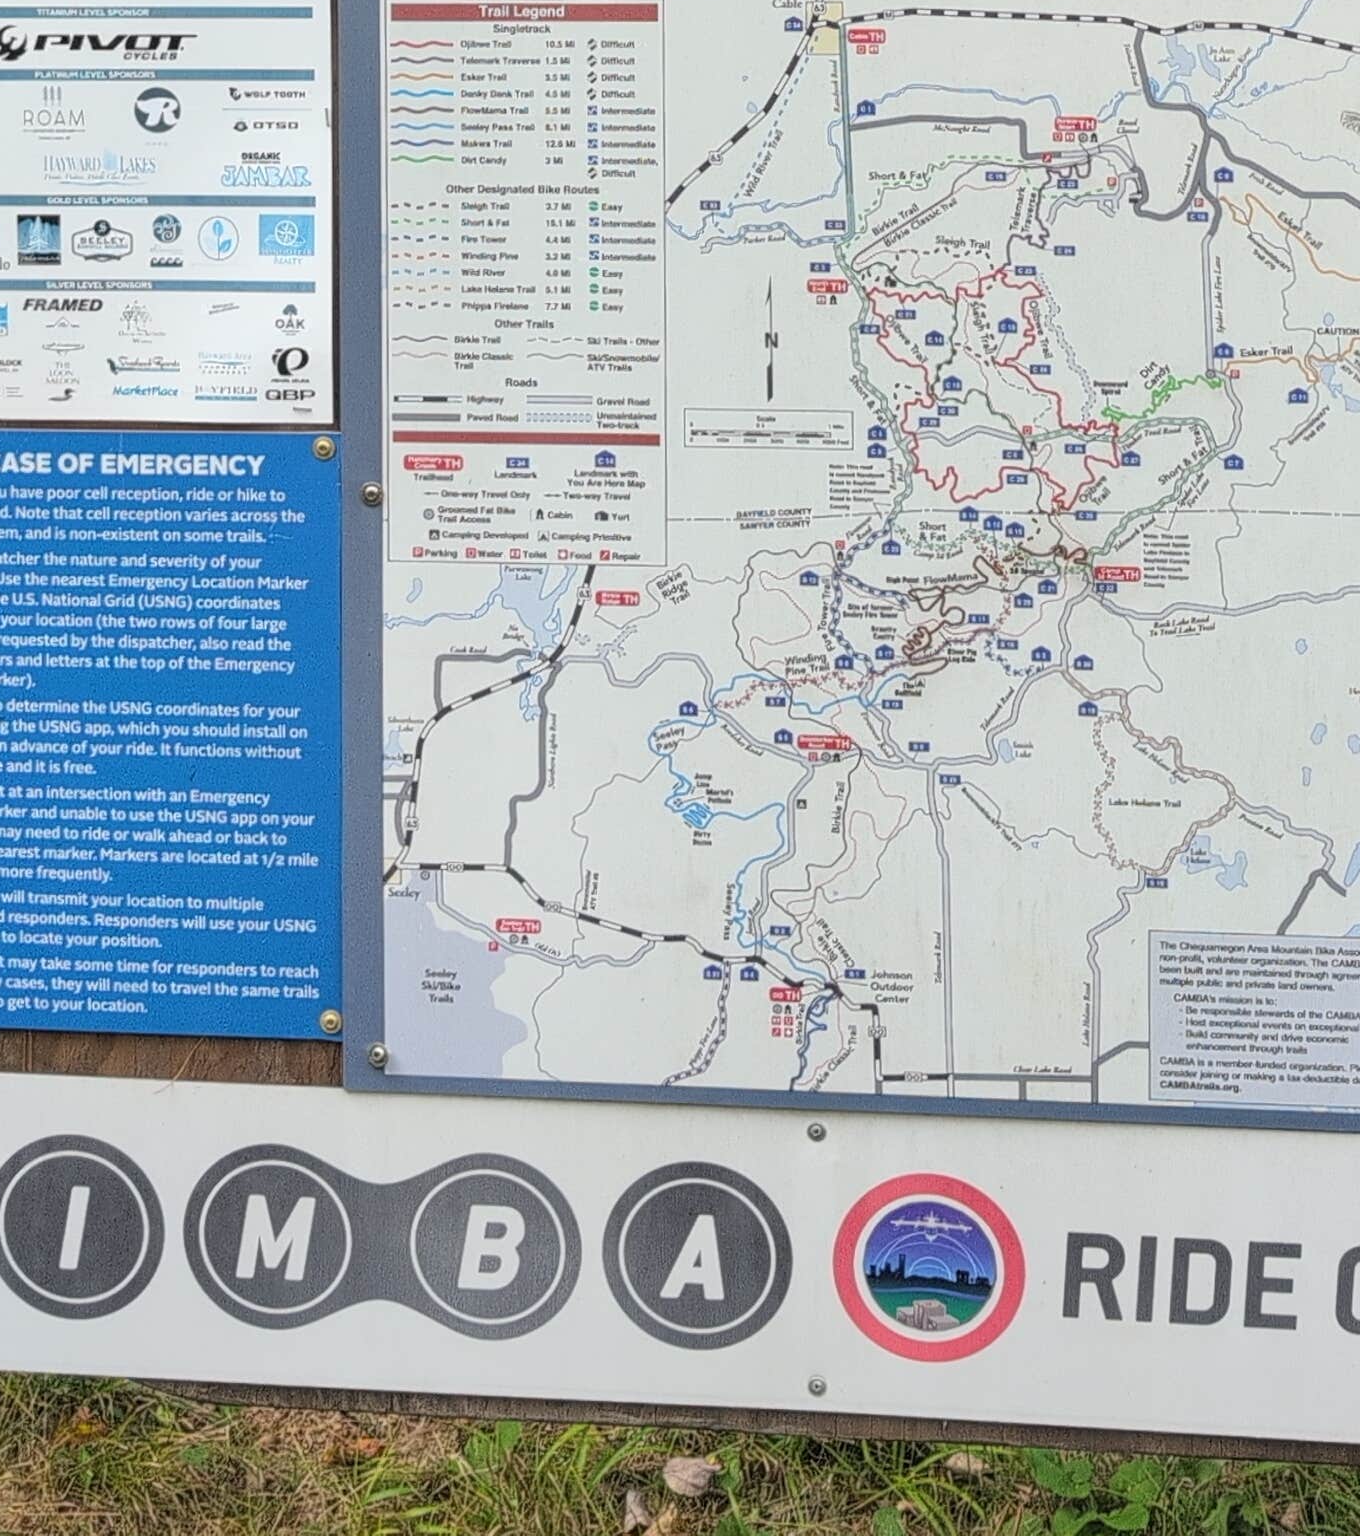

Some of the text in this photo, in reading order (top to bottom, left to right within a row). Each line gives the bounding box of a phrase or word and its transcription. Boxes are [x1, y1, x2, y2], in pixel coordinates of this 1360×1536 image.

[479, 5, 564, 20] Trail Legend
[493, 24, 550, 35] Singletrack
[34, 35, 196, 54] PIVOT
[446, 184, 599, 195] Other Designated Bike Routes
[23, 299, 103, 311] FRAMED
[1240, 345, 1293, 357] Esker Trail
[58, 453, 93, 474] OF
[101, 453, 264, 476] EMERGENCY
[1063, 1232, 1302, 1331] RIDE
